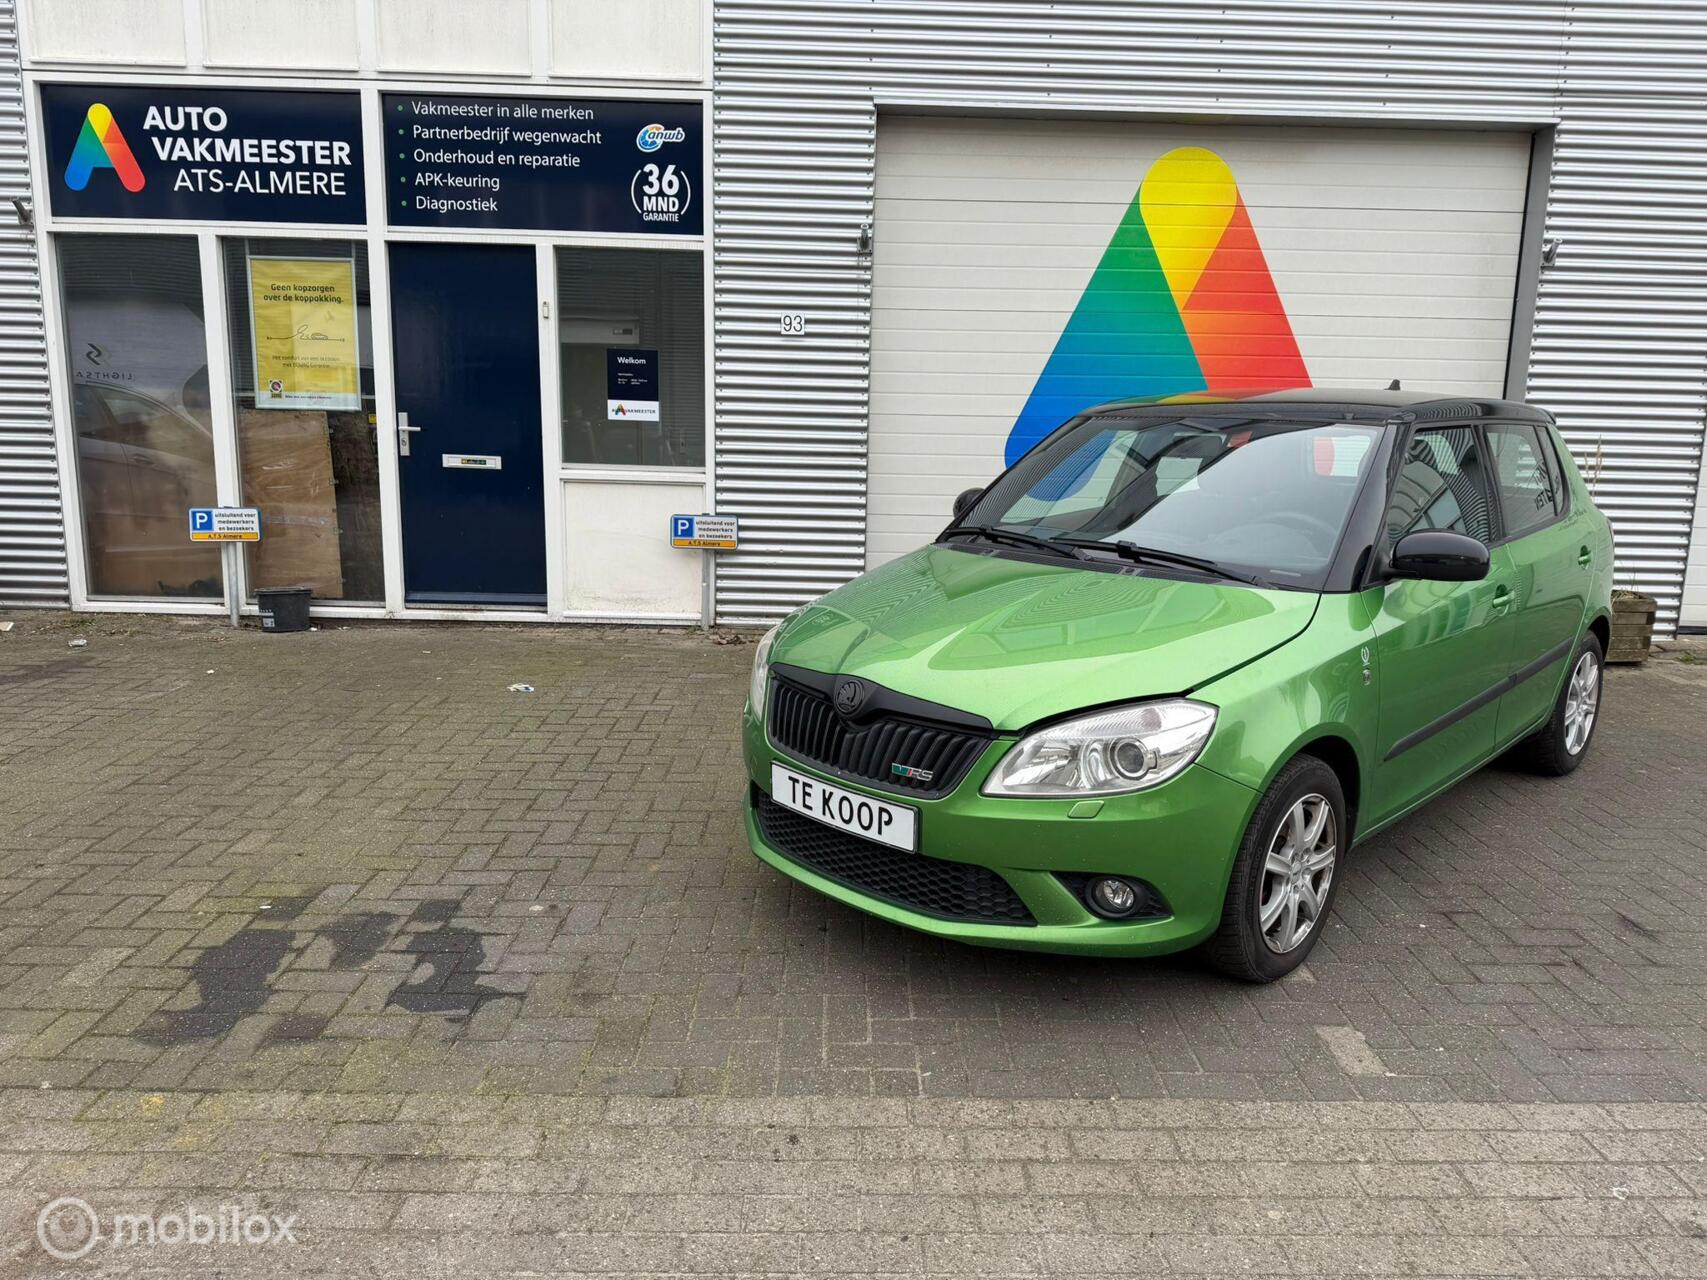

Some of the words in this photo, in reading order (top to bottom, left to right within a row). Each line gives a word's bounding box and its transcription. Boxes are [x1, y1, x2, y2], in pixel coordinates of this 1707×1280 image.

[143, 106, 228, 132] AUTO
[412, 101, 493, 116] Vakmeester
[497, 104, 510, 117] in
[514, 104, 538, 118] alle
[542, 106, 594, 120] merken
[413, 125, 510, 144] Partnerbedrijf
[513, 130, 602, 145] wegenwacht
[151, 136, 352, 166] VAKMEESTER
[414, 148, 494, 164] Onderhoud
[498, 154, 514, 165] en
[519, 154, 580, 168] reparatie
[174, 168, 346, 195] ATS-ALMERE
[415, 173, 500, 191] APK-keuring
[642, 163, 680, 196] 36
[416, 196, 498, 213] Diagnostiek
[643, 196, 680, 212] MND
[642, 212, 680, 222] GARANTIE
[293, 284, 335, 293] kopzorgen
[783, 315, 802, 332] 93
[195, 512, 208, 528] P
[678, 520, 689, 536] P
[788, 776, 813, 811] TE
[822, 788, 893, 835] KOOP
